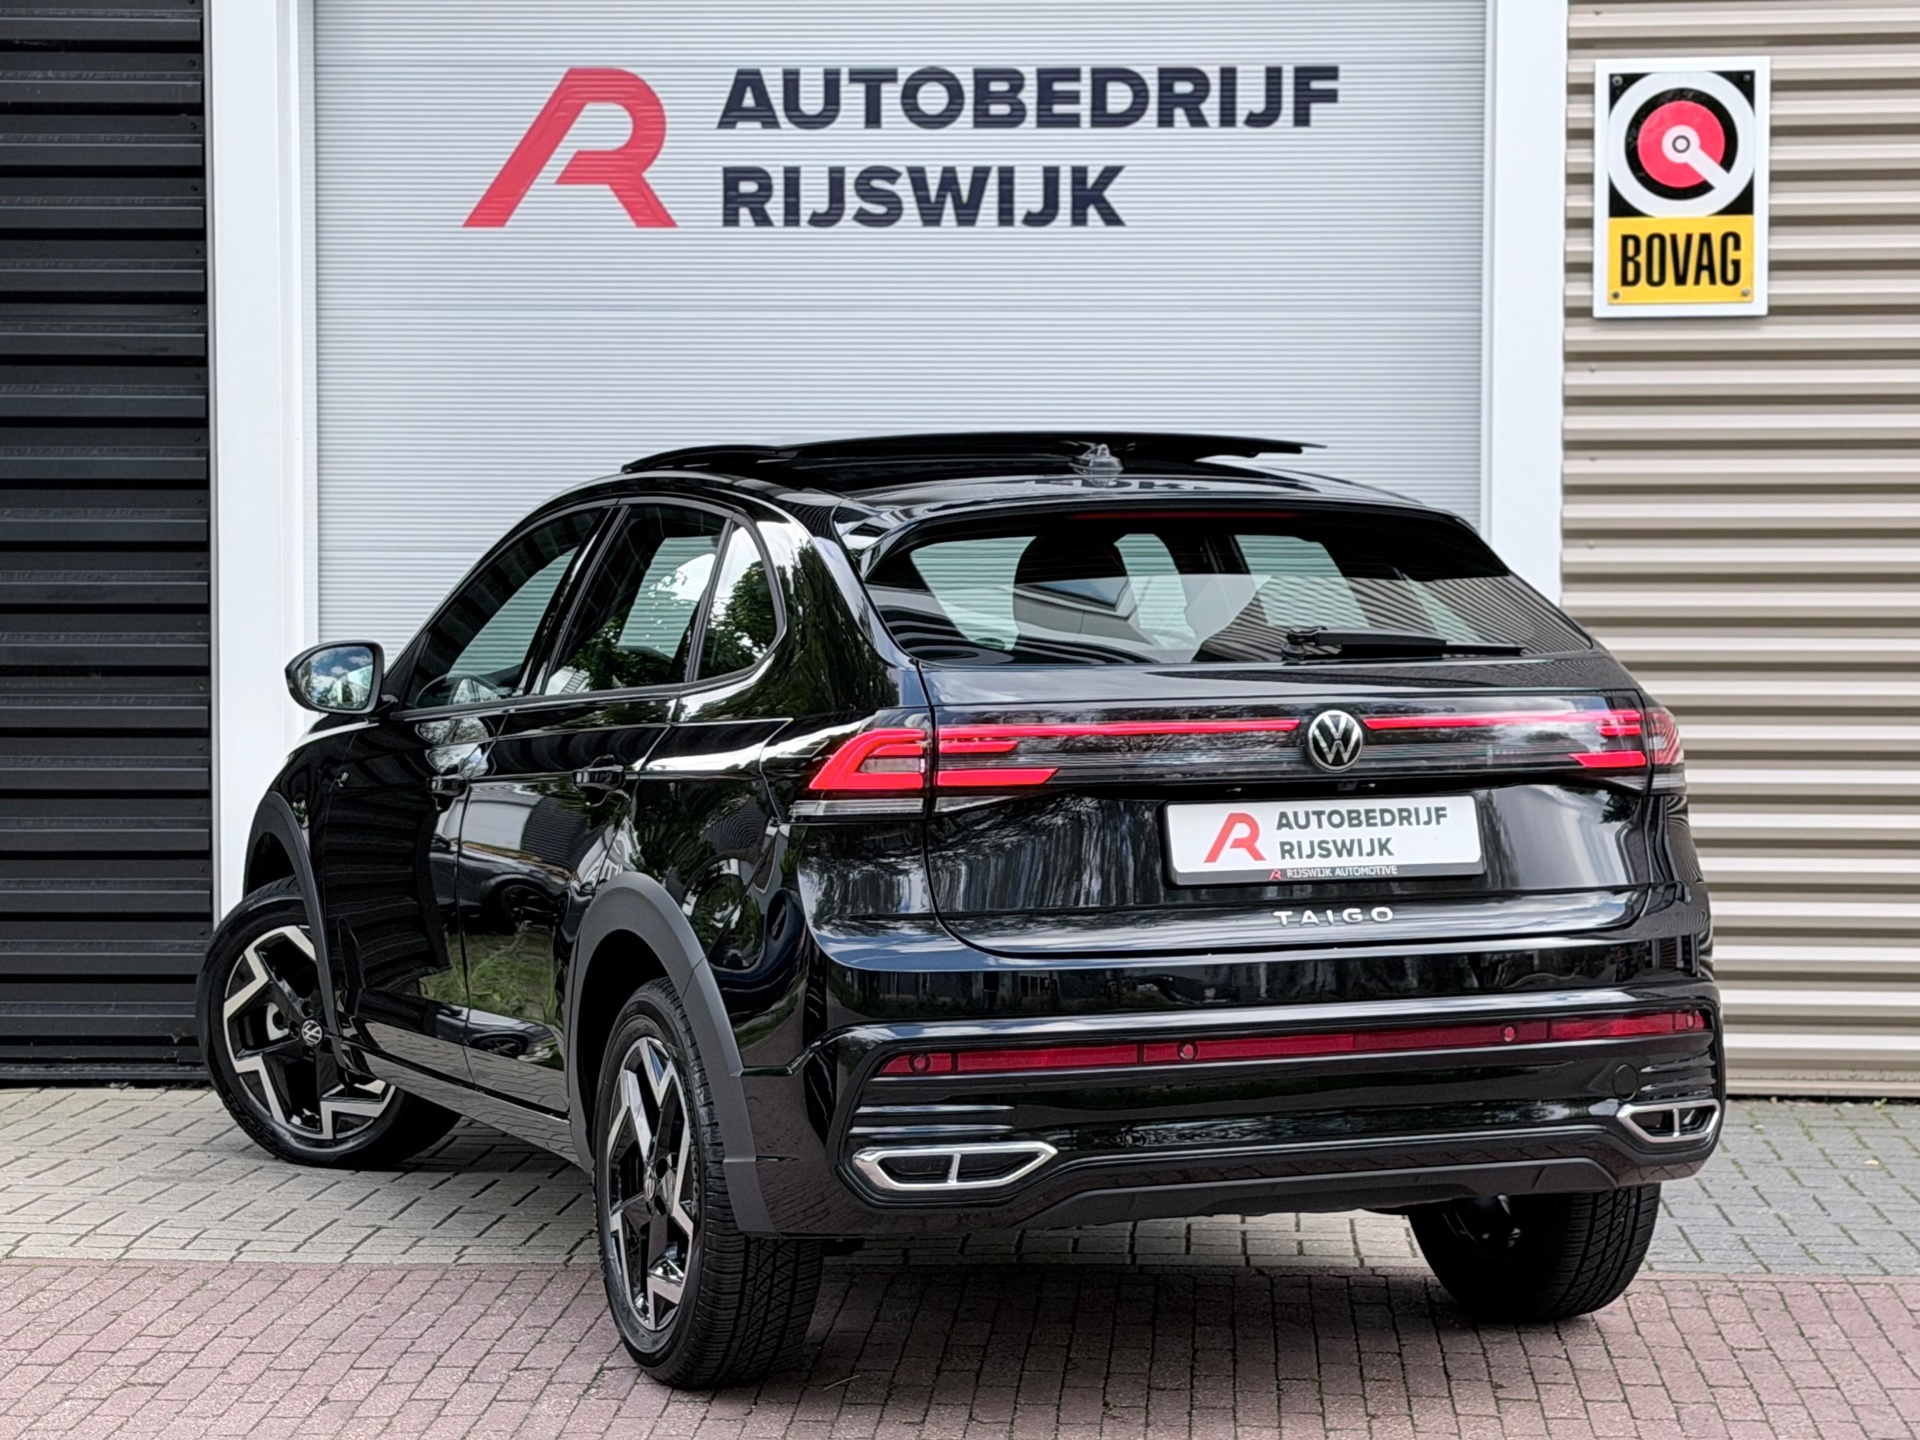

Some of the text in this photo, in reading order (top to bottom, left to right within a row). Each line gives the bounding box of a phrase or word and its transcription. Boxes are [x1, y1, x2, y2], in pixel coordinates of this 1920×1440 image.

[717, 66, 1340, 130] AUTOBEDRIJF
[721, 165, 1127, 229] RIJSWIJK
[1620, 231, 1742, 288] BOVAG
[1275, 806, 1449, 831] AUTOBEDRIJF
[1279, 837, 1395, 860] RIJSWIJK
[1286, 868, 1333, 879] RIJSWIJK
[1334, 865, 1398, 877] AUTOMOTIVE
[1272, 907, 1394, 927] TAIGO
